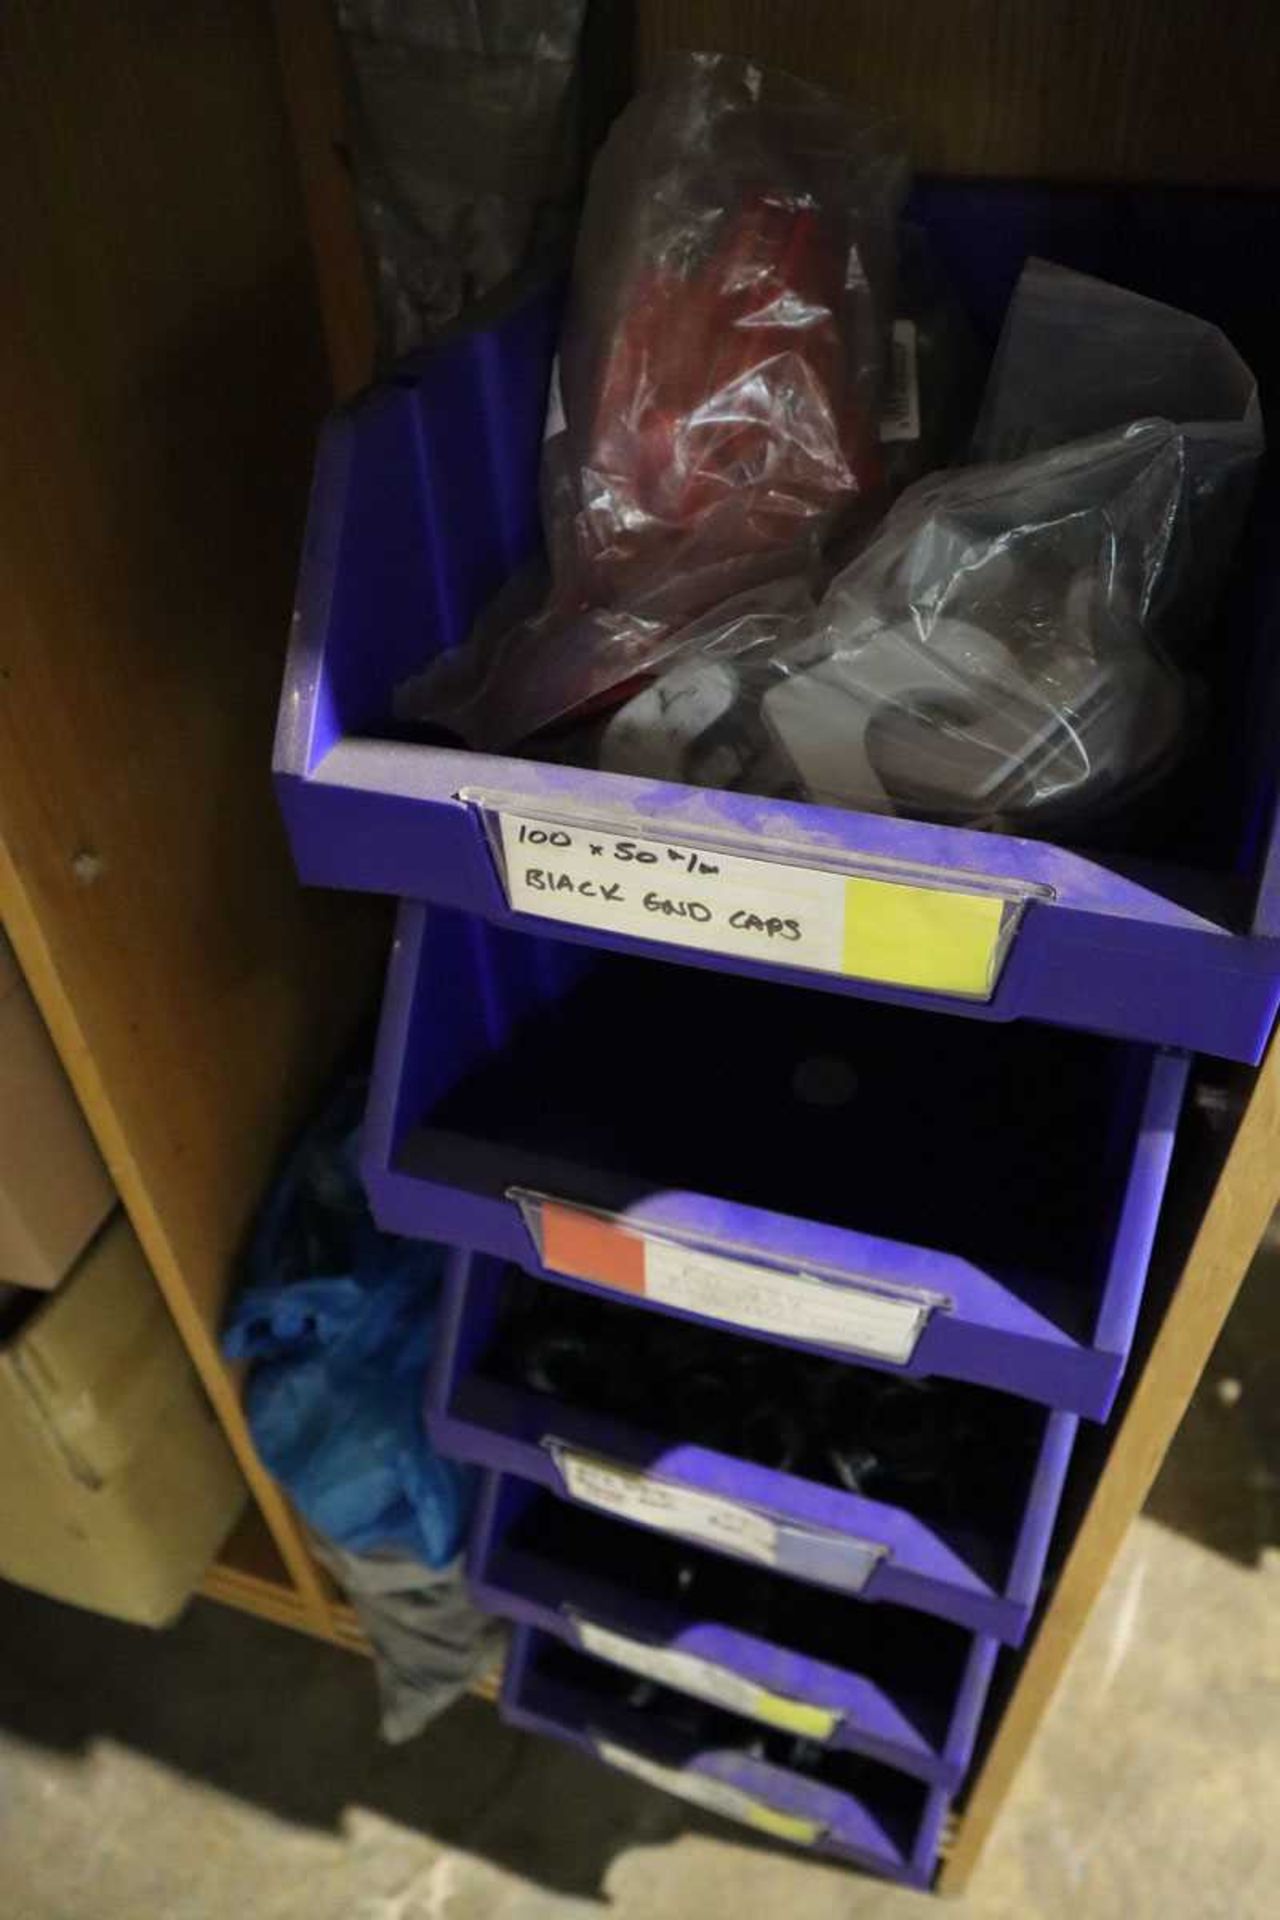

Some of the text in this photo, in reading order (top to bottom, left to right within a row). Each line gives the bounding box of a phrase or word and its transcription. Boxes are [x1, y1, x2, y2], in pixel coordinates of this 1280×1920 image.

[519, 825, 572, 847] 100
[613, 842, 659, 864] 50
[728, 910, 802, 941] CAPS
